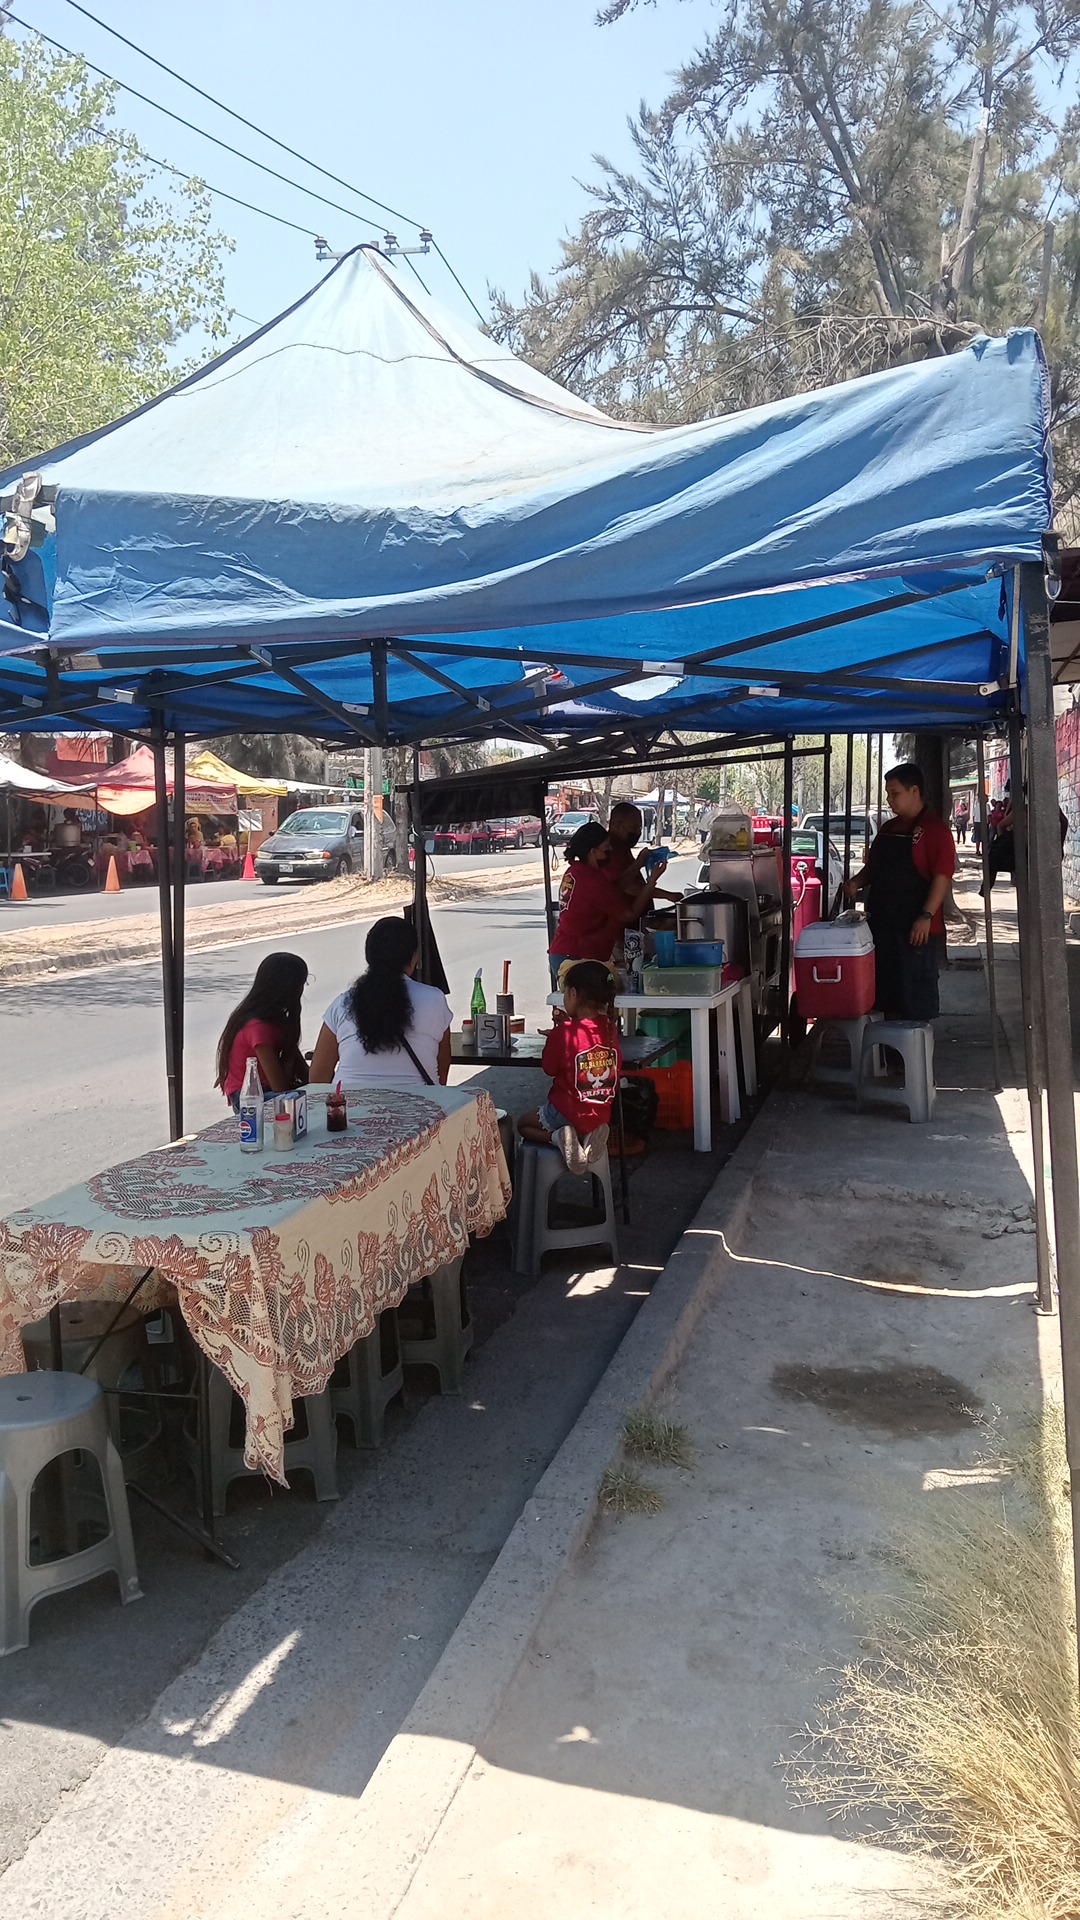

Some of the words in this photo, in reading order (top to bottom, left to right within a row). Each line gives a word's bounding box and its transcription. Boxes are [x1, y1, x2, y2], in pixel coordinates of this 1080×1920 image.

[580, 1062, 588, 1070] DE
[582, 1089, 611, 1098] CRISTY
[298, 1103, 304, 1129] 6
